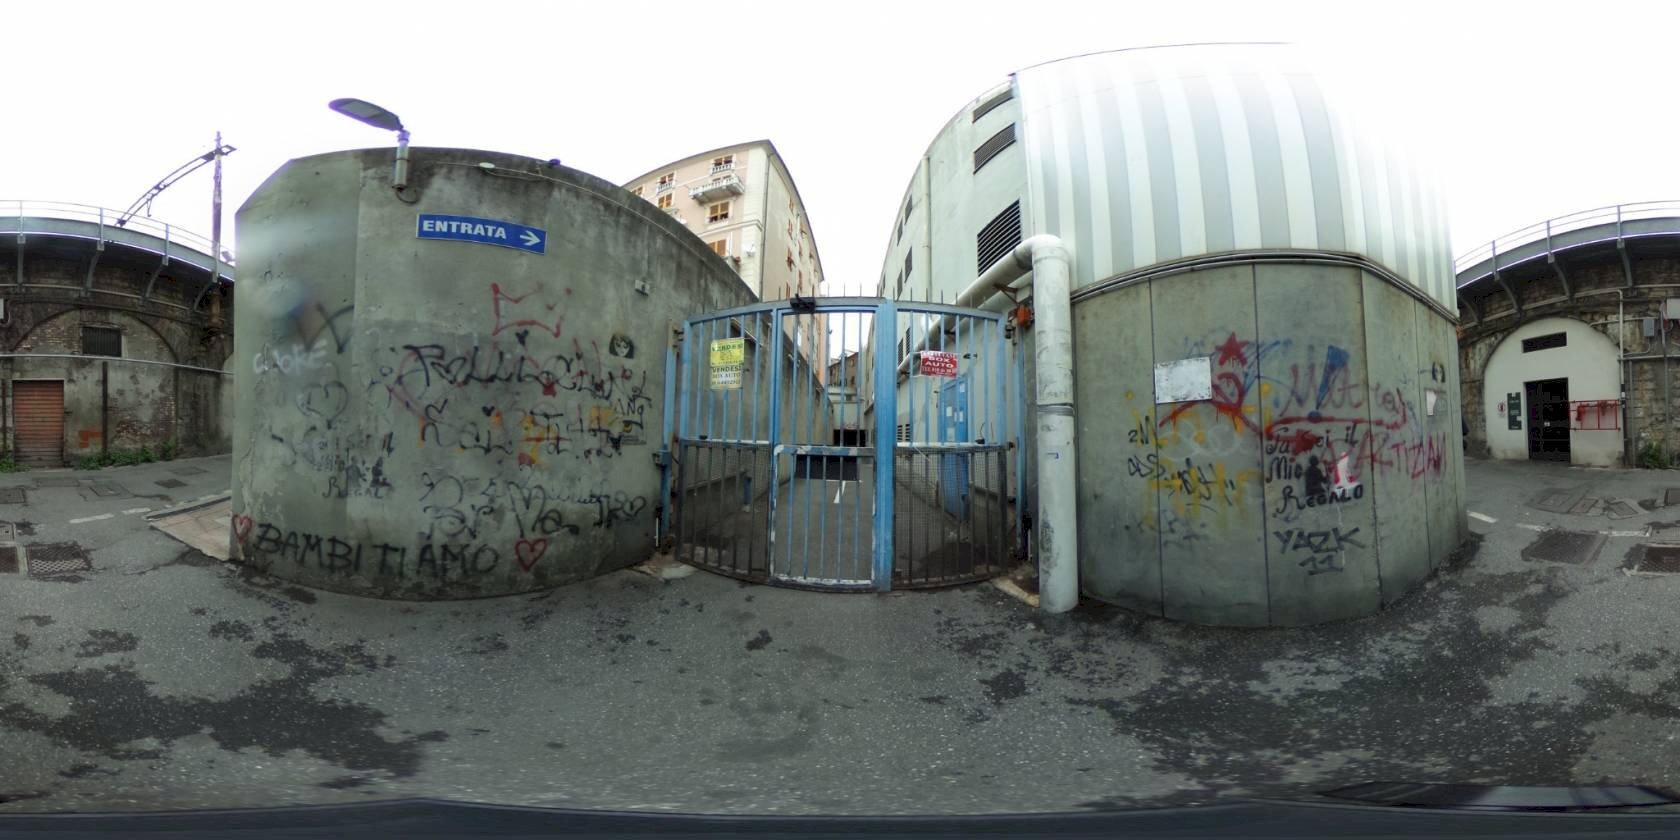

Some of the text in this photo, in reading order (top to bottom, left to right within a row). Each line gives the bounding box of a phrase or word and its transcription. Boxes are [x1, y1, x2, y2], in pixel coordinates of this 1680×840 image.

[422, 220, 507, 240] ENTRATA
[252, 523, 500, 577] BAMBI TI AMO
